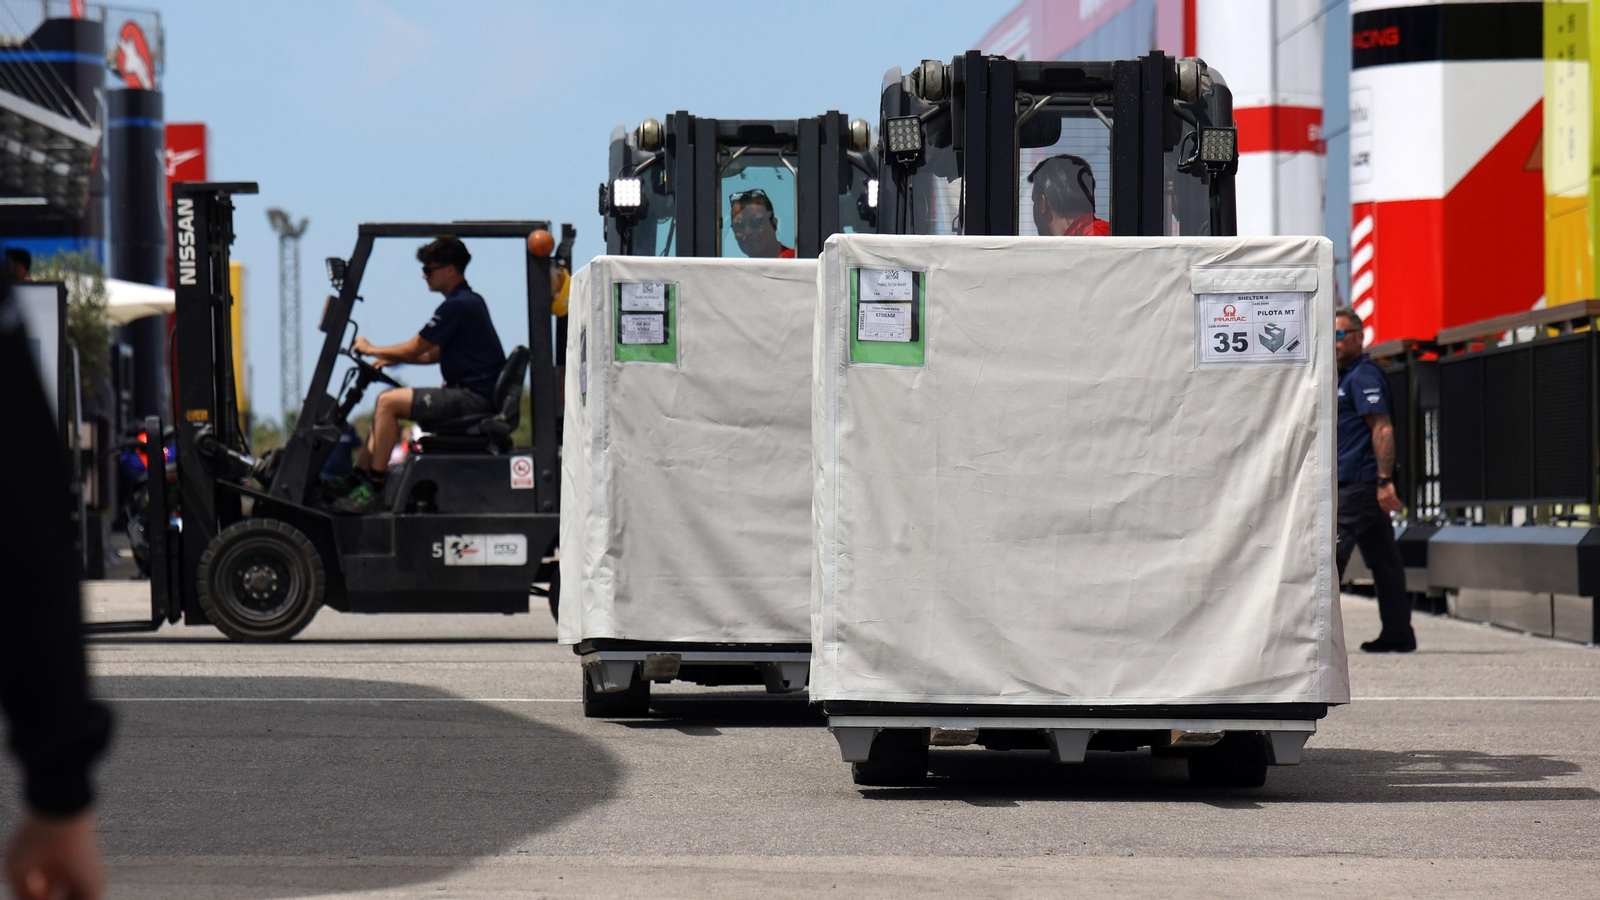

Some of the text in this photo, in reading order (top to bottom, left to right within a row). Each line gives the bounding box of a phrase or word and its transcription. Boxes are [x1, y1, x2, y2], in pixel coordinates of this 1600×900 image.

[177, 198, 197, 285] NISSAN
[1213, 331, 1249, 353] 35
[431, 542, 443, 558] 5
